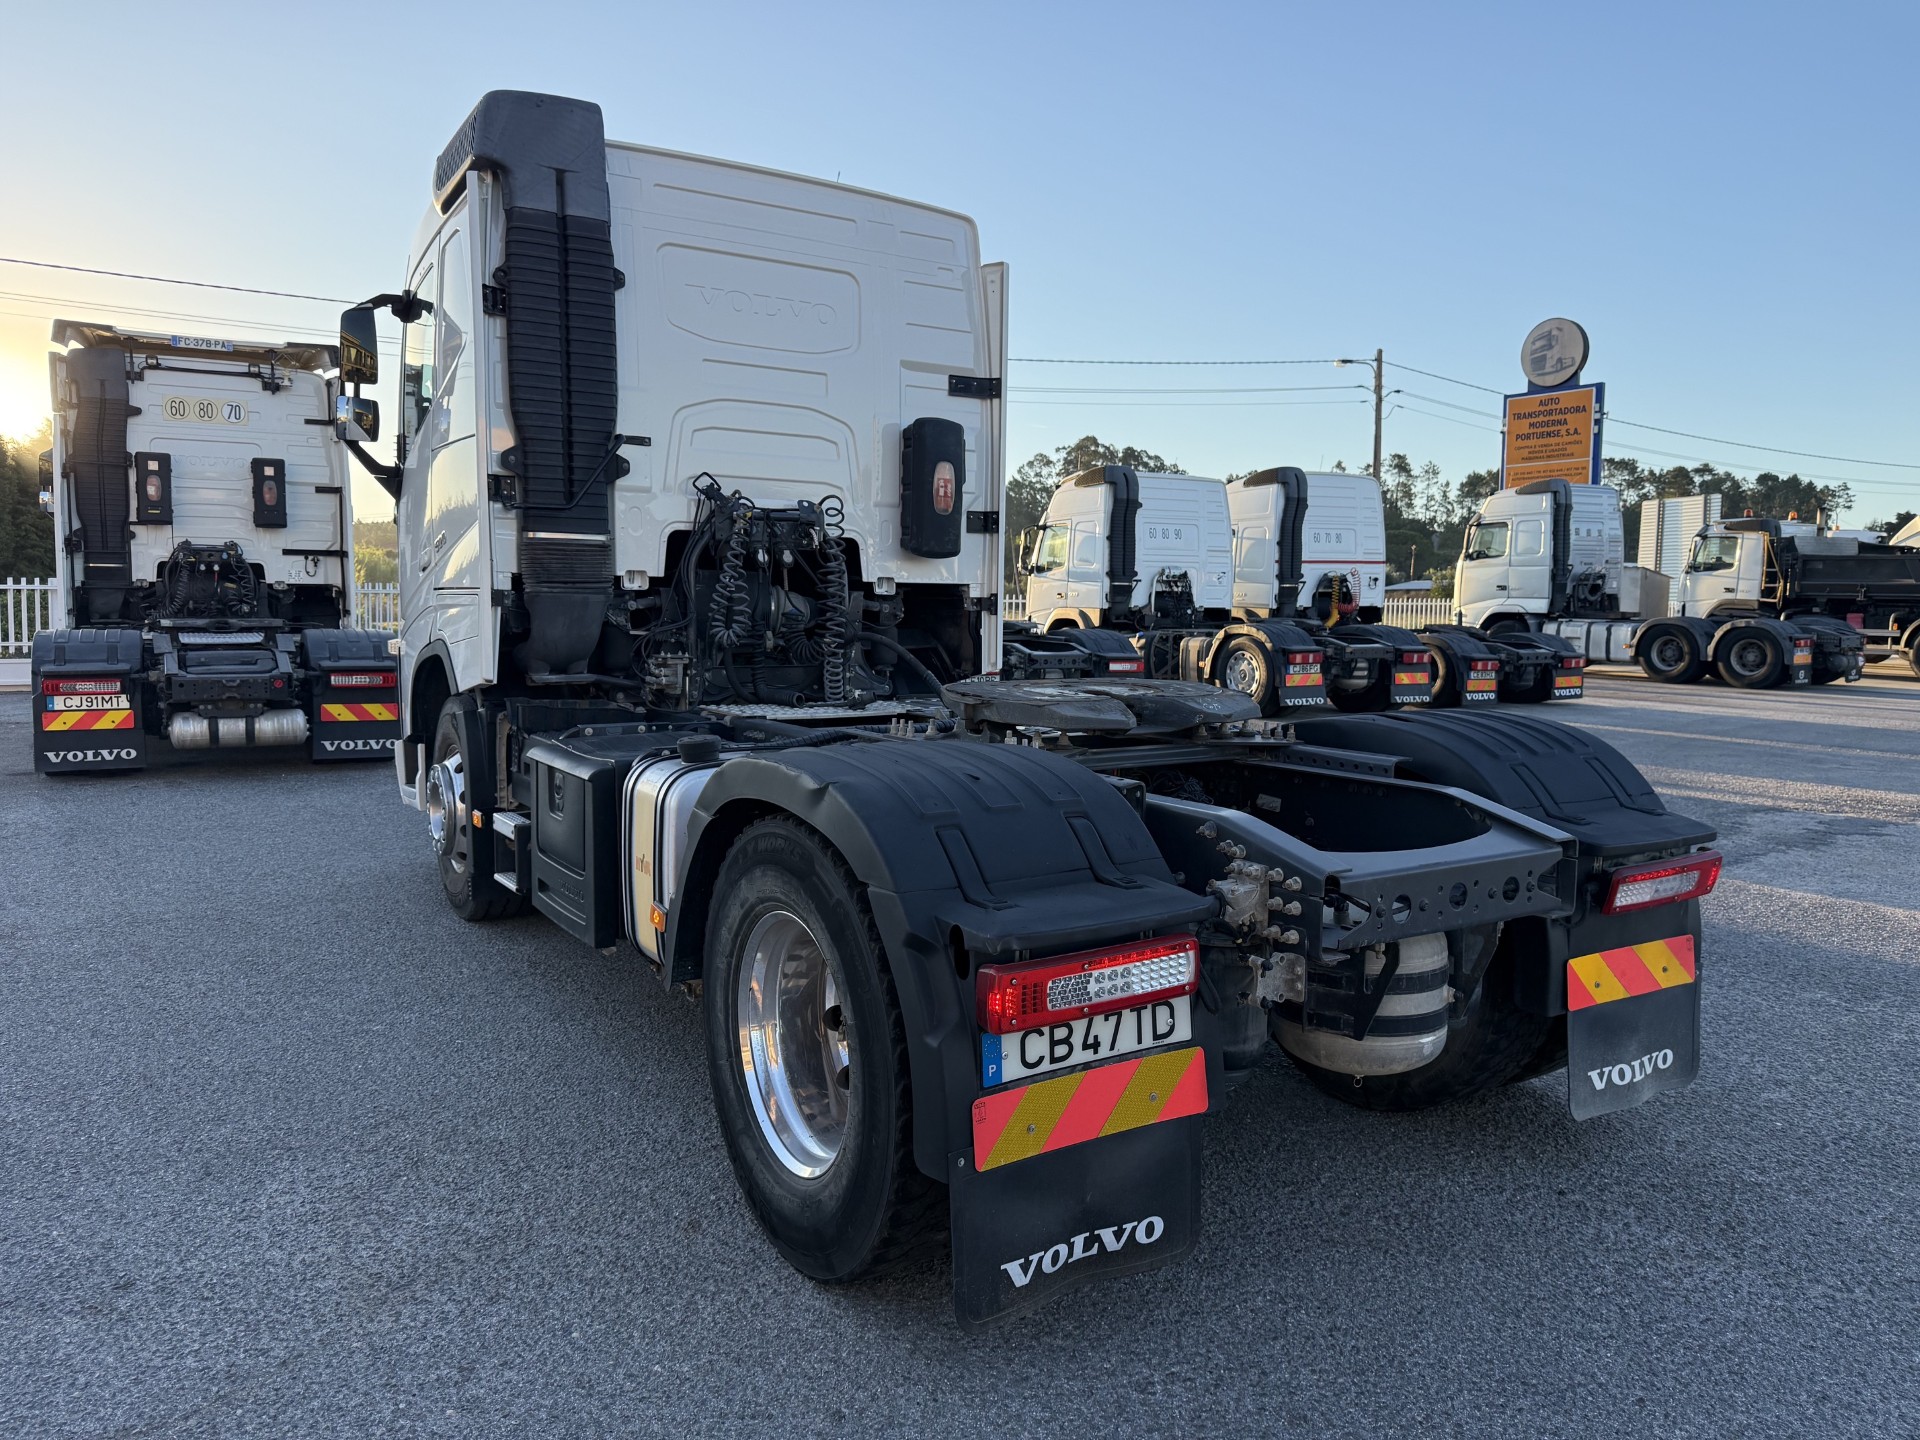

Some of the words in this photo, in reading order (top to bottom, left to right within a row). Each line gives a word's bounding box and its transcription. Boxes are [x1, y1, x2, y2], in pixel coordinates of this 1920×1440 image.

[684, 283, 838, 326] VOLVO
[1538, 397, 1560, 406] AUTO
[170, 400, 186, 417] 60
[198, 402, 214, 419] 80
[226, 403, 242, 421] 70
[1512, 405, 1587, 420] TRANSPORTADORA
[1528, 418, 1568, 429] MODERNA
[1515, 431, 1564, 441] PORTUENSE,
[1565, 428, 1581, 436] S.A.
[1148, 527, 1157, 539] 60
[1161, 528, 1170, 540] 80
[1173, 528, 1182, 540] 90
[1313, 532, 1321, 543] 60
[1324, 532, 1332, 543] 70
[1394, 695, 1430, 703] VOLVO
[1465, 692, 1495, 701] VOLVO
[1554, 688, 1581, 697] VOLVO
[63, 696, 121, 709] CJ91MT
[1284, 697, 1325, 706] VOLVO
[43, 748, 139, 763] VOLVO
[988, 1065, 997, 1077] P
[1587, 1048, 1674, 1091] VOLVO
[1000, 1215, 1165, 1288] VOLVO
